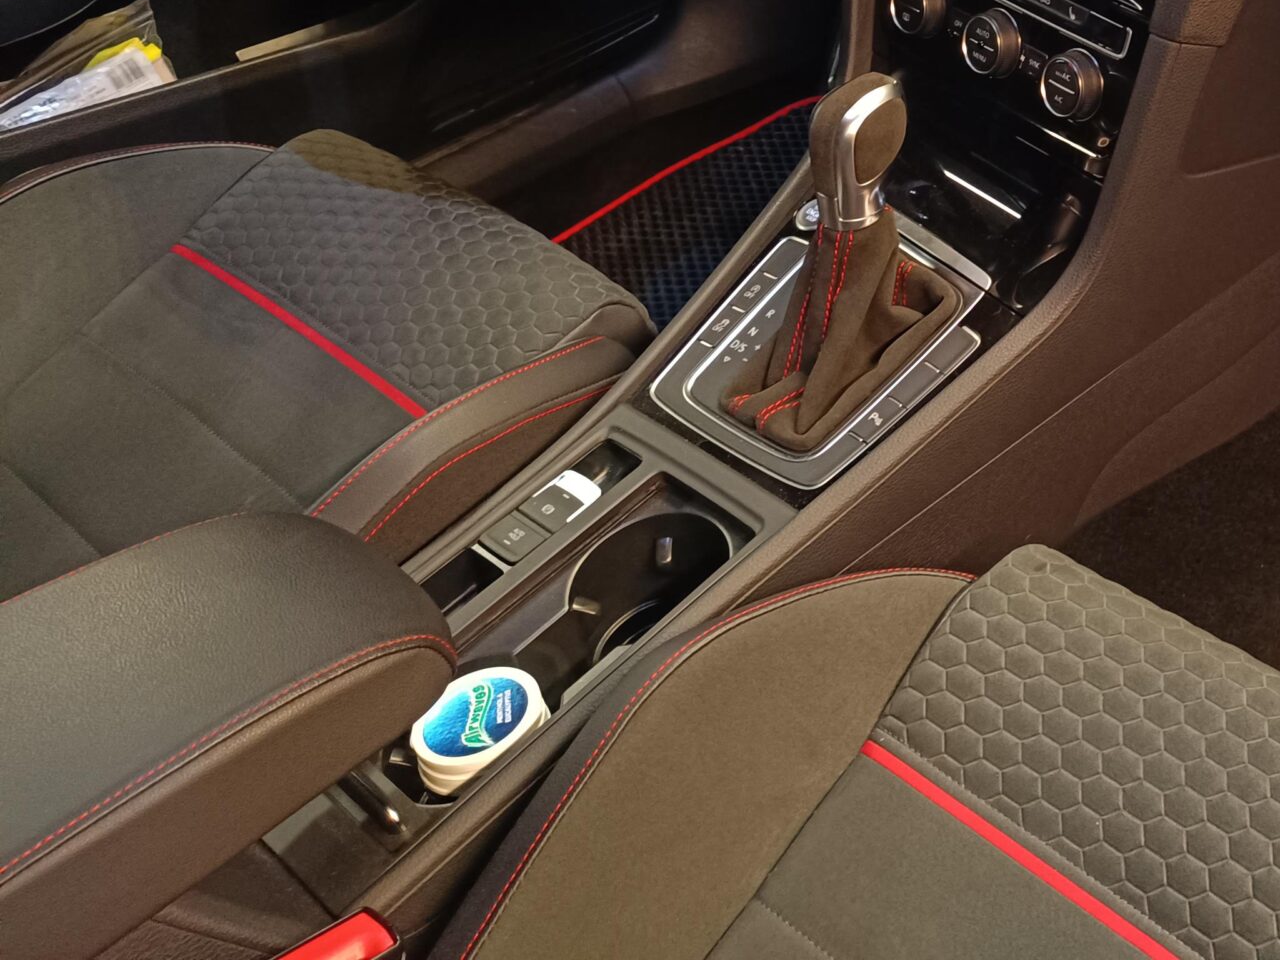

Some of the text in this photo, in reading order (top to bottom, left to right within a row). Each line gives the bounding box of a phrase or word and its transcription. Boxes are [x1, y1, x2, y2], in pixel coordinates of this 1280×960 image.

[976, 27, 990, 39] AUTO
[765, 309, 776, 318] R
[747, 326, 760, 337] N
[730, 339, 748, 353] D/S
